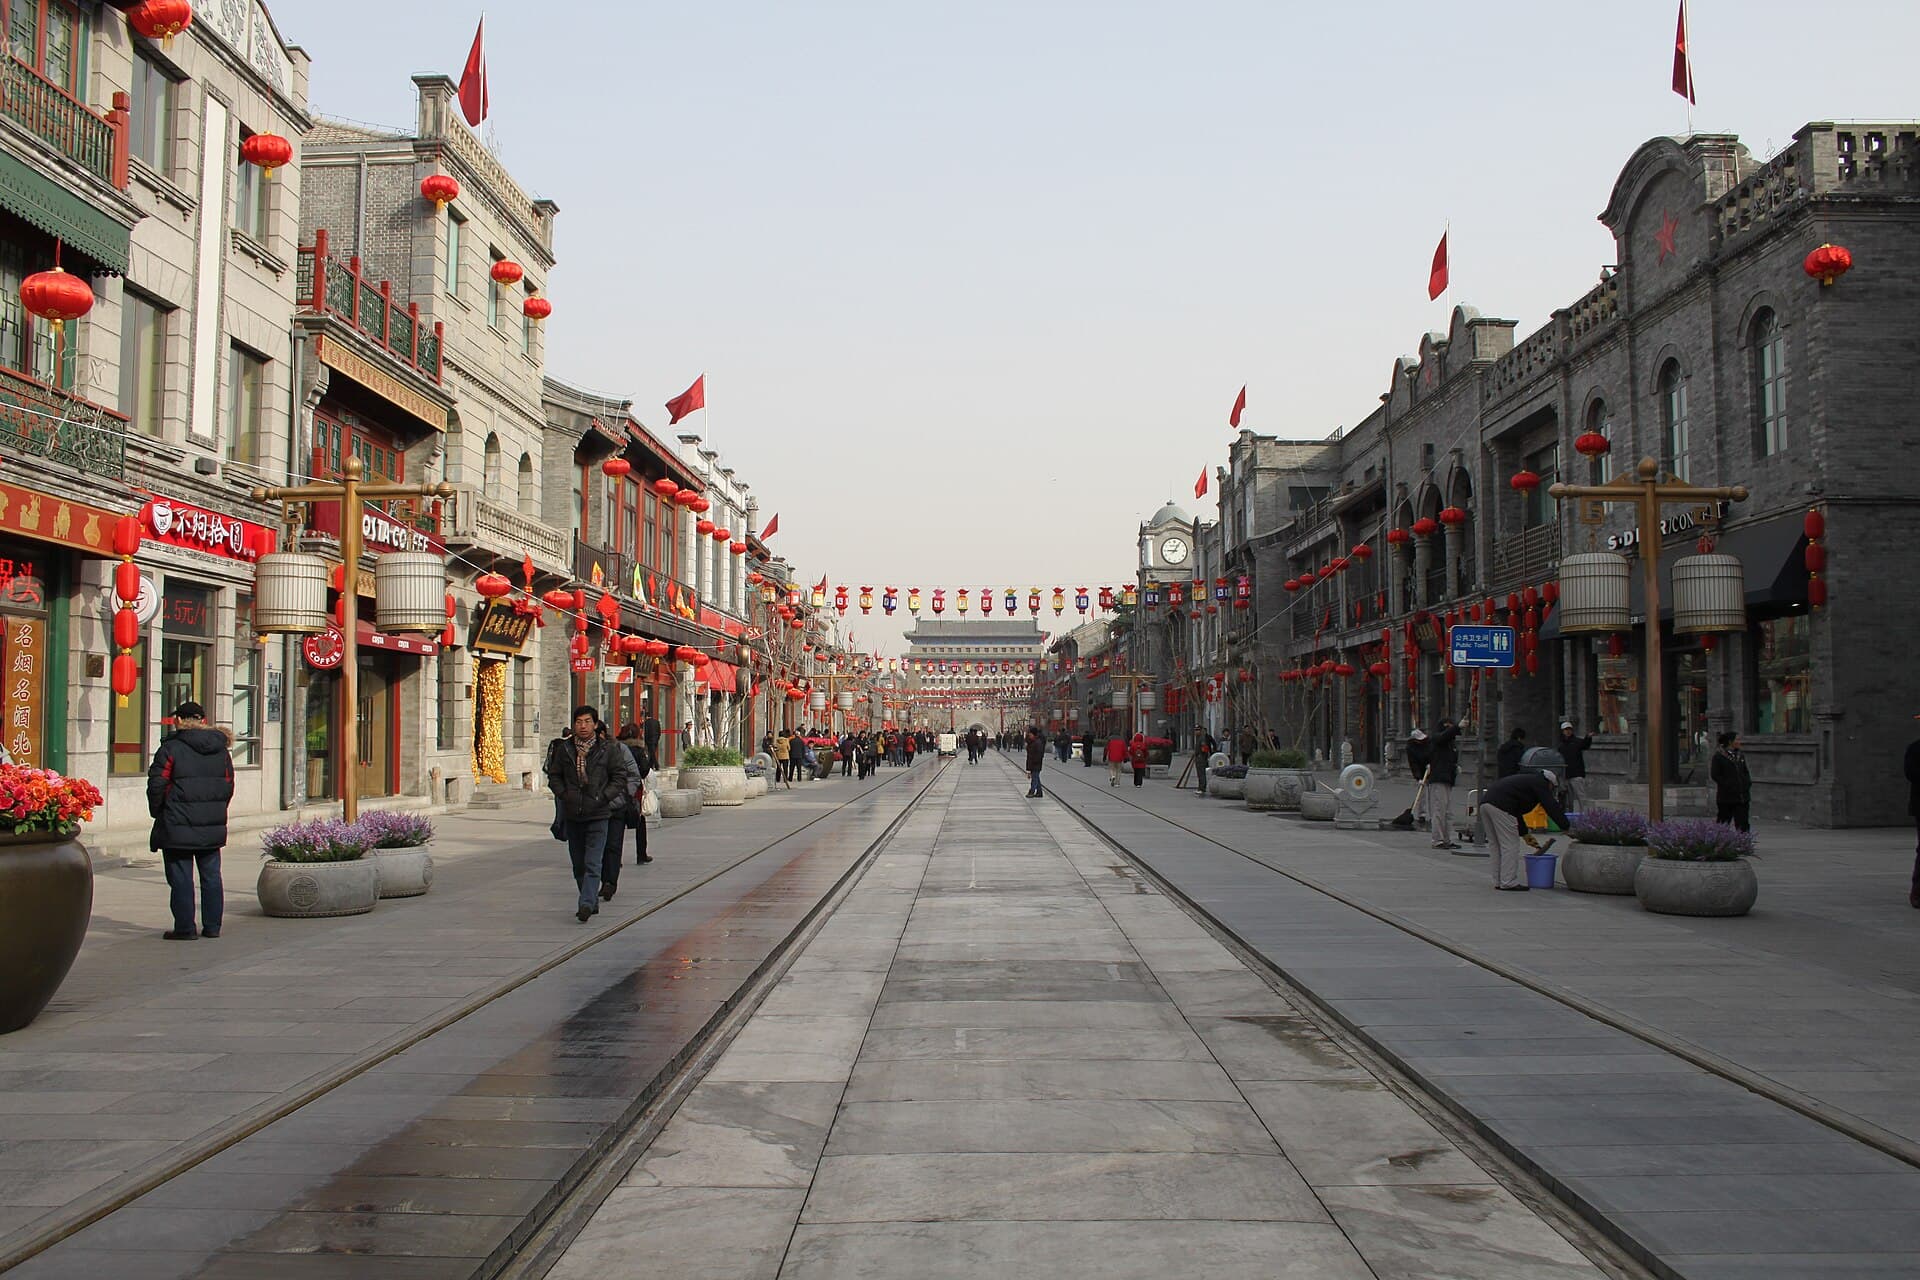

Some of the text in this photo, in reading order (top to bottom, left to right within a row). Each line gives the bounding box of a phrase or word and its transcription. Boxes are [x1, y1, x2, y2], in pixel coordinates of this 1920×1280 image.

[362, 514, 390, 544] OSTA
[1455, 634, 1488, 642] 公共卫生间
[310, 651, 341, 665] COFFEE
